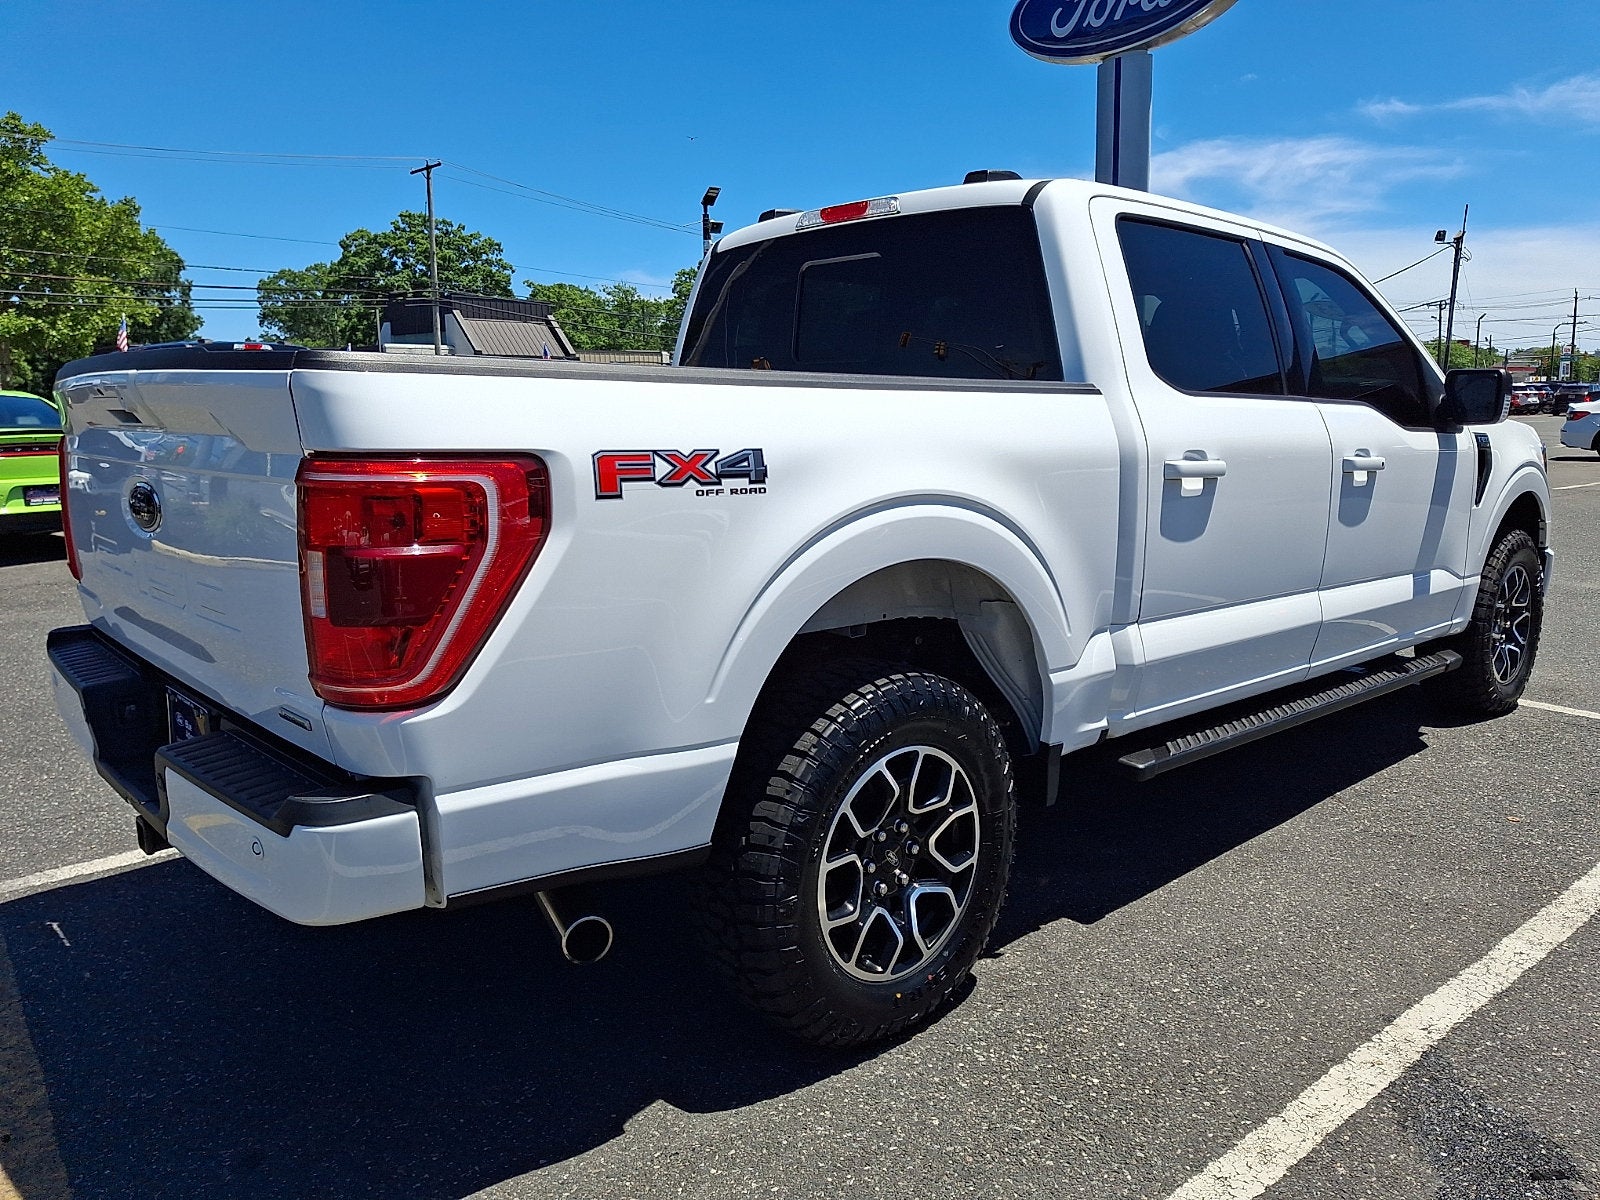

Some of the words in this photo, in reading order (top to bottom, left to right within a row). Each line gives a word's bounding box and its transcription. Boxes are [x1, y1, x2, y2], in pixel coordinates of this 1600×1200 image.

[592, 448, 768, 500] FX4
[695, 489, 725, 497] OFF
[729, 487, 767, 496] ROAD
